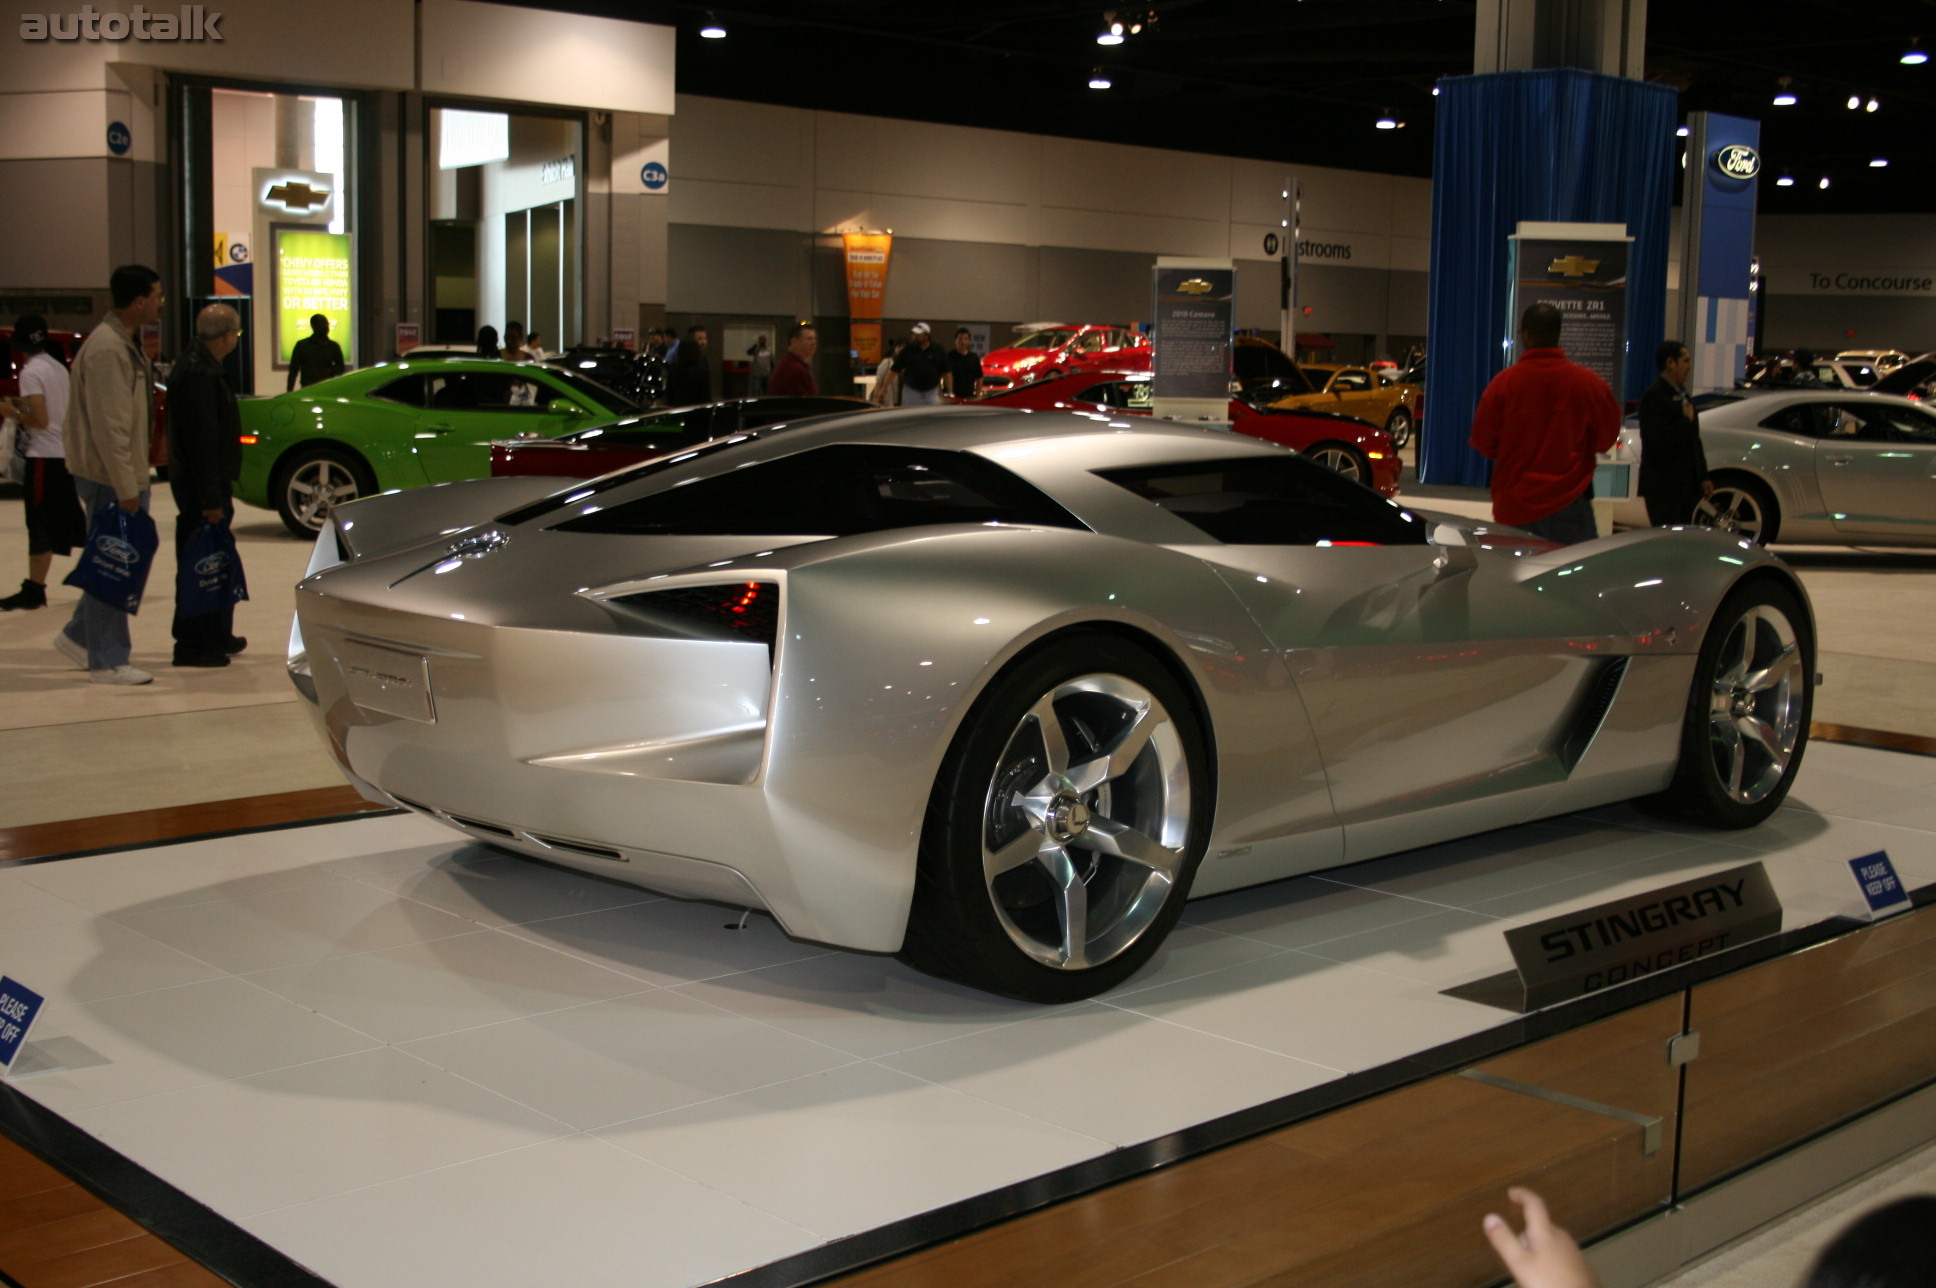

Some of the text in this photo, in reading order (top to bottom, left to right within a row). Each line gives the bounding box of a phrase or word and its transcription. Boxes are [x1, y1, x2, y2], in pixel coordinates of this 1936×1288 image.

[1727, 148, 1756, 174] Ford
[643, 170, 665, 181] C3a
[283, 257, 349, 270] CHEVY OFFERS
[1810, 272, 1933, 291] To Concourse
[284, 296, 349, 311] OR BETTER
[1586, 301, 1604, 311] ZR1
[1172, 310, 1216, 318] 2010 Camaro
[1860, 861, 1888, 881] PLEASE
[1865, 875, 1897, 897] KEEP OFF
[1540, 878, 1745, 964] STINGRAY
[1584, 931, 1730, 993] CONCEPT
[1, 1022, 21, 1044] OFF
